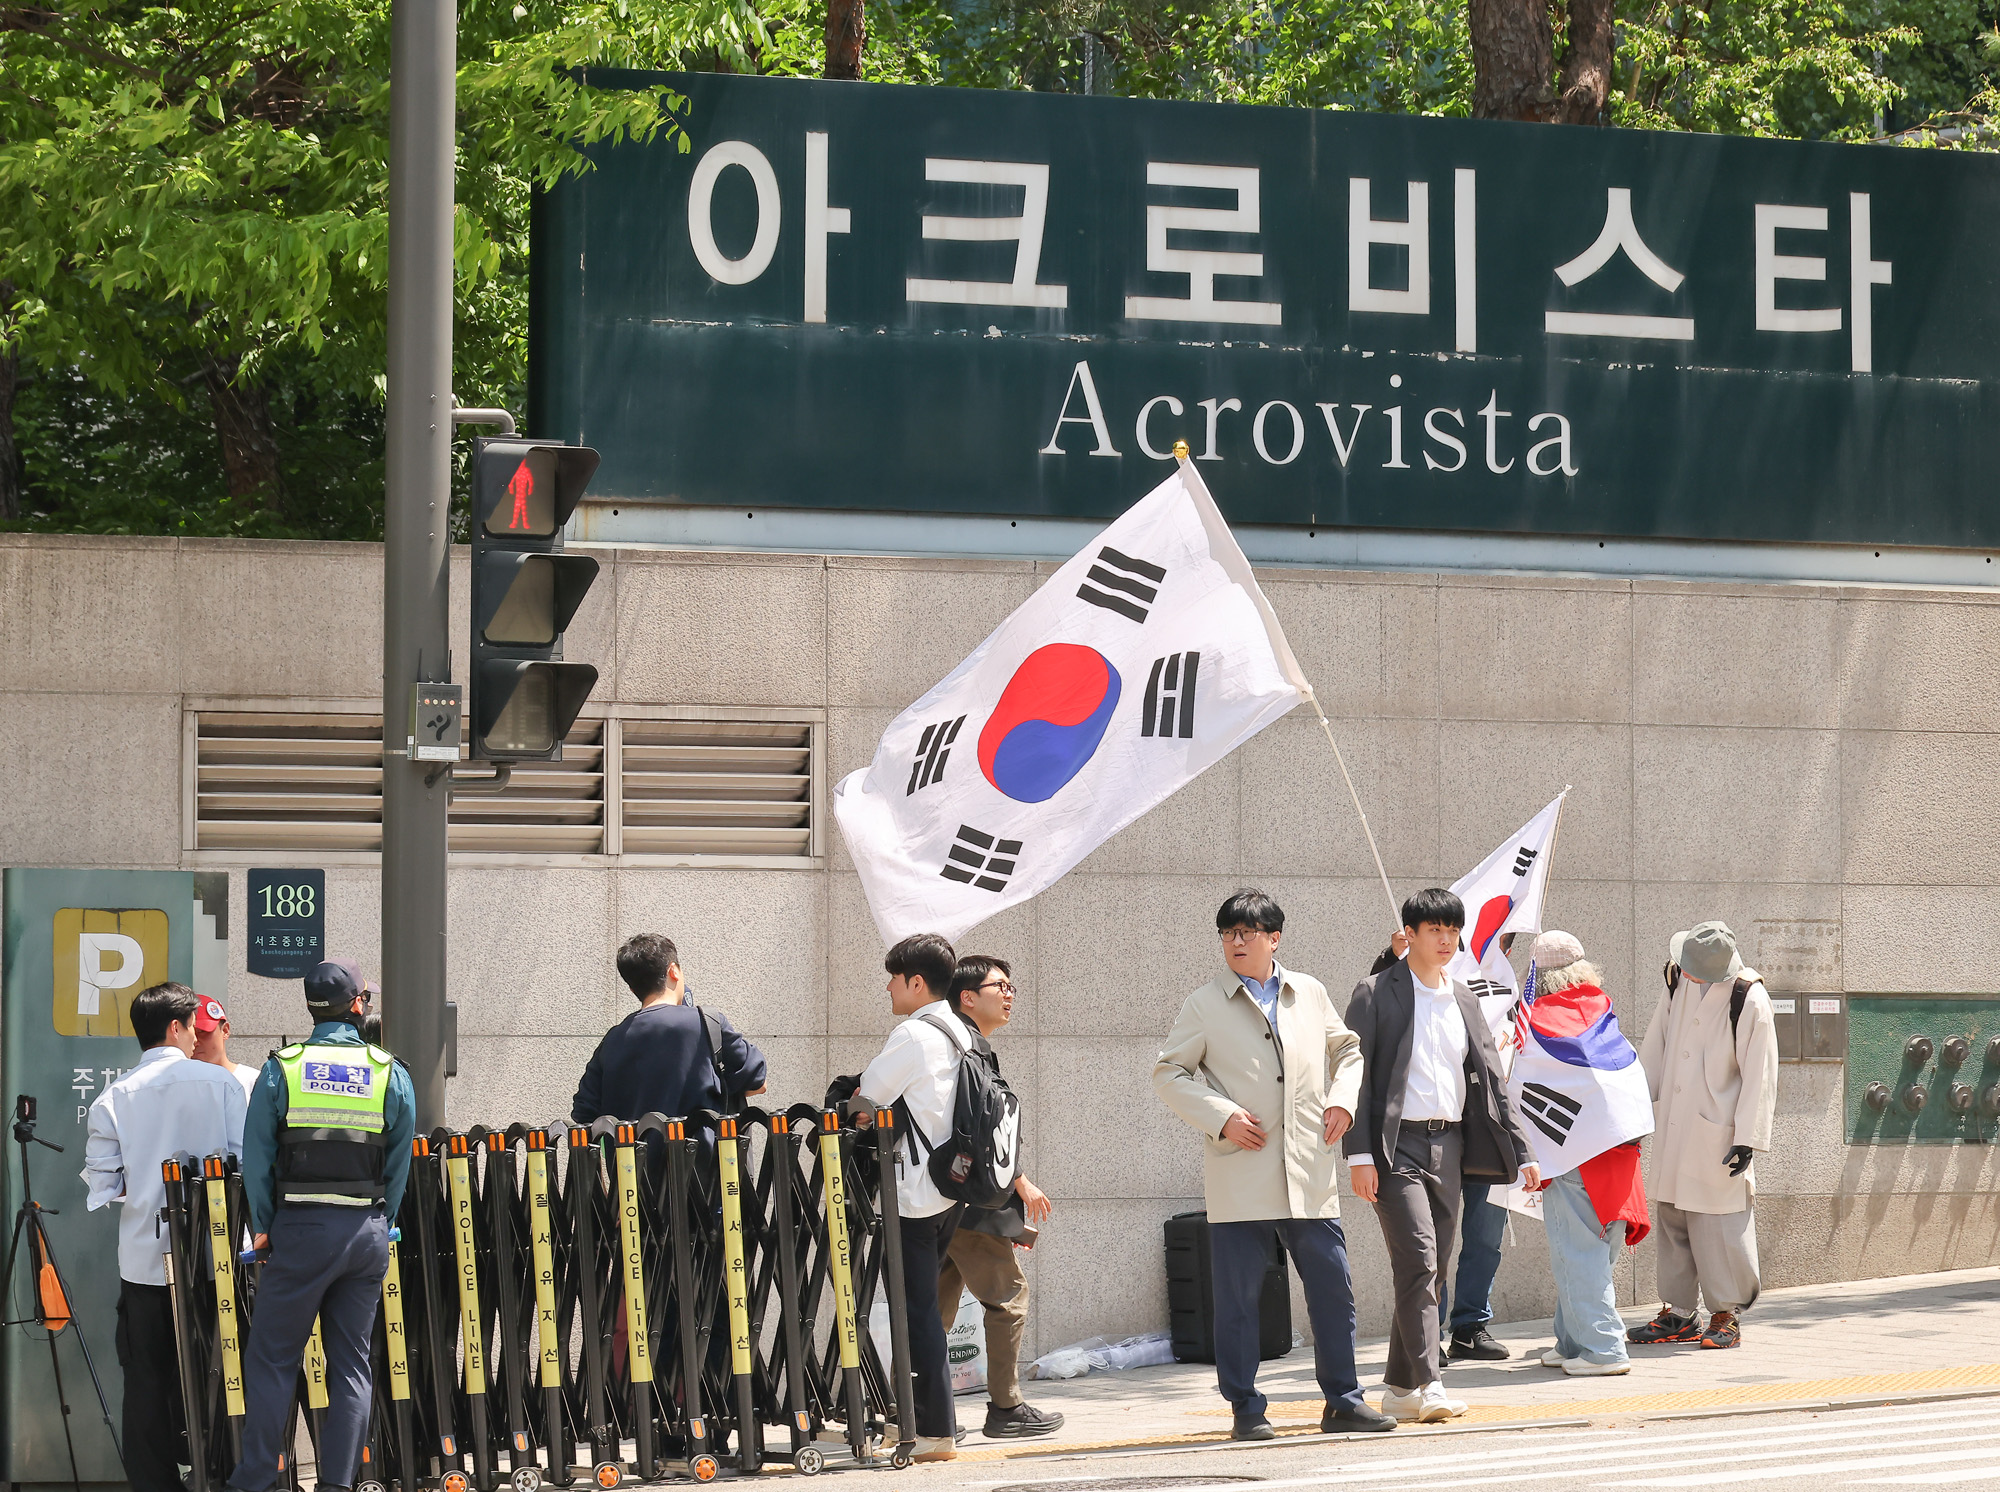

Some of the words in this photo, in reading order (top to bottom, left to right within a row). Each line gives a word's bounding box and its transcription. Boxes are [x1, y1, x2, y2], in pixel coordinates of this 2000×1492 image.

[687, 131, 1893, 373] 아크로비스타
[1039, 359, 1580, 478] Acrovista
[255, 935, 318, 948] 서초중앙로
[258, 884, 315, 918] 188
[77, 933, 144, 1015] P
[310, 1081, 365, 1095] POLICE
[312, 1063, 366, 1084] 경찰
[211, 1221, 241, 1391] 질서유지선
[386, 1244, 407, 1376] 서유지선
[459, 1200, 475, 1291] POLICE
[468, 1310, 480, 1369] LINE
[535, 1193, 558, 1363] 질서유지선
[626, 1189, 641, 1280] POLICE
[634, 1298, 646, 1358] LINE
[726, 1182, 750, 1350] 질서유지선
[832, 1176, 848, 1267] POLICE
[842, 1285, 856, 1344] LINE
[948, 1348, 977, 1359] ENDING
